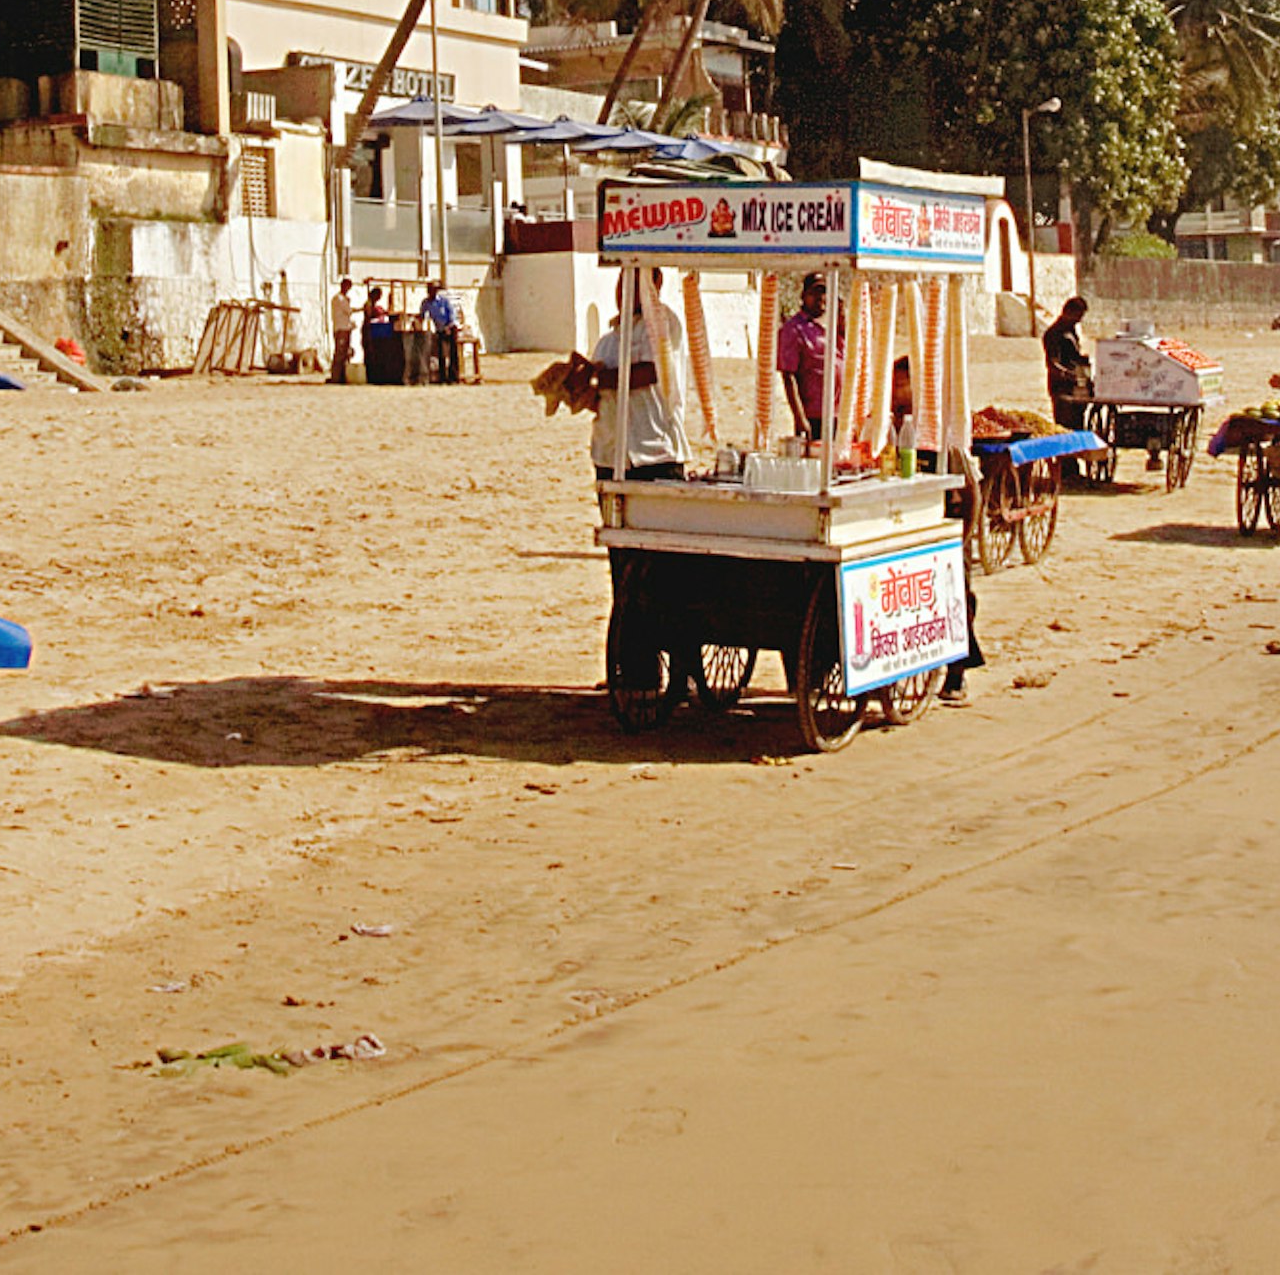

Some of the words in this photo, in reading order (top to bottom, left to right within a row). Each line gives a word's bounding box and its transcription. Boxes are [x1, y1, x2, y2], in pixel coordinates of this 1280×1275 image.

[602, 197, 705, 239] MEWAD
[742, 201, 768, 232] MIX
[771, 202, 794, 233] ICE
[797, 202, 845, 232] CREAM
